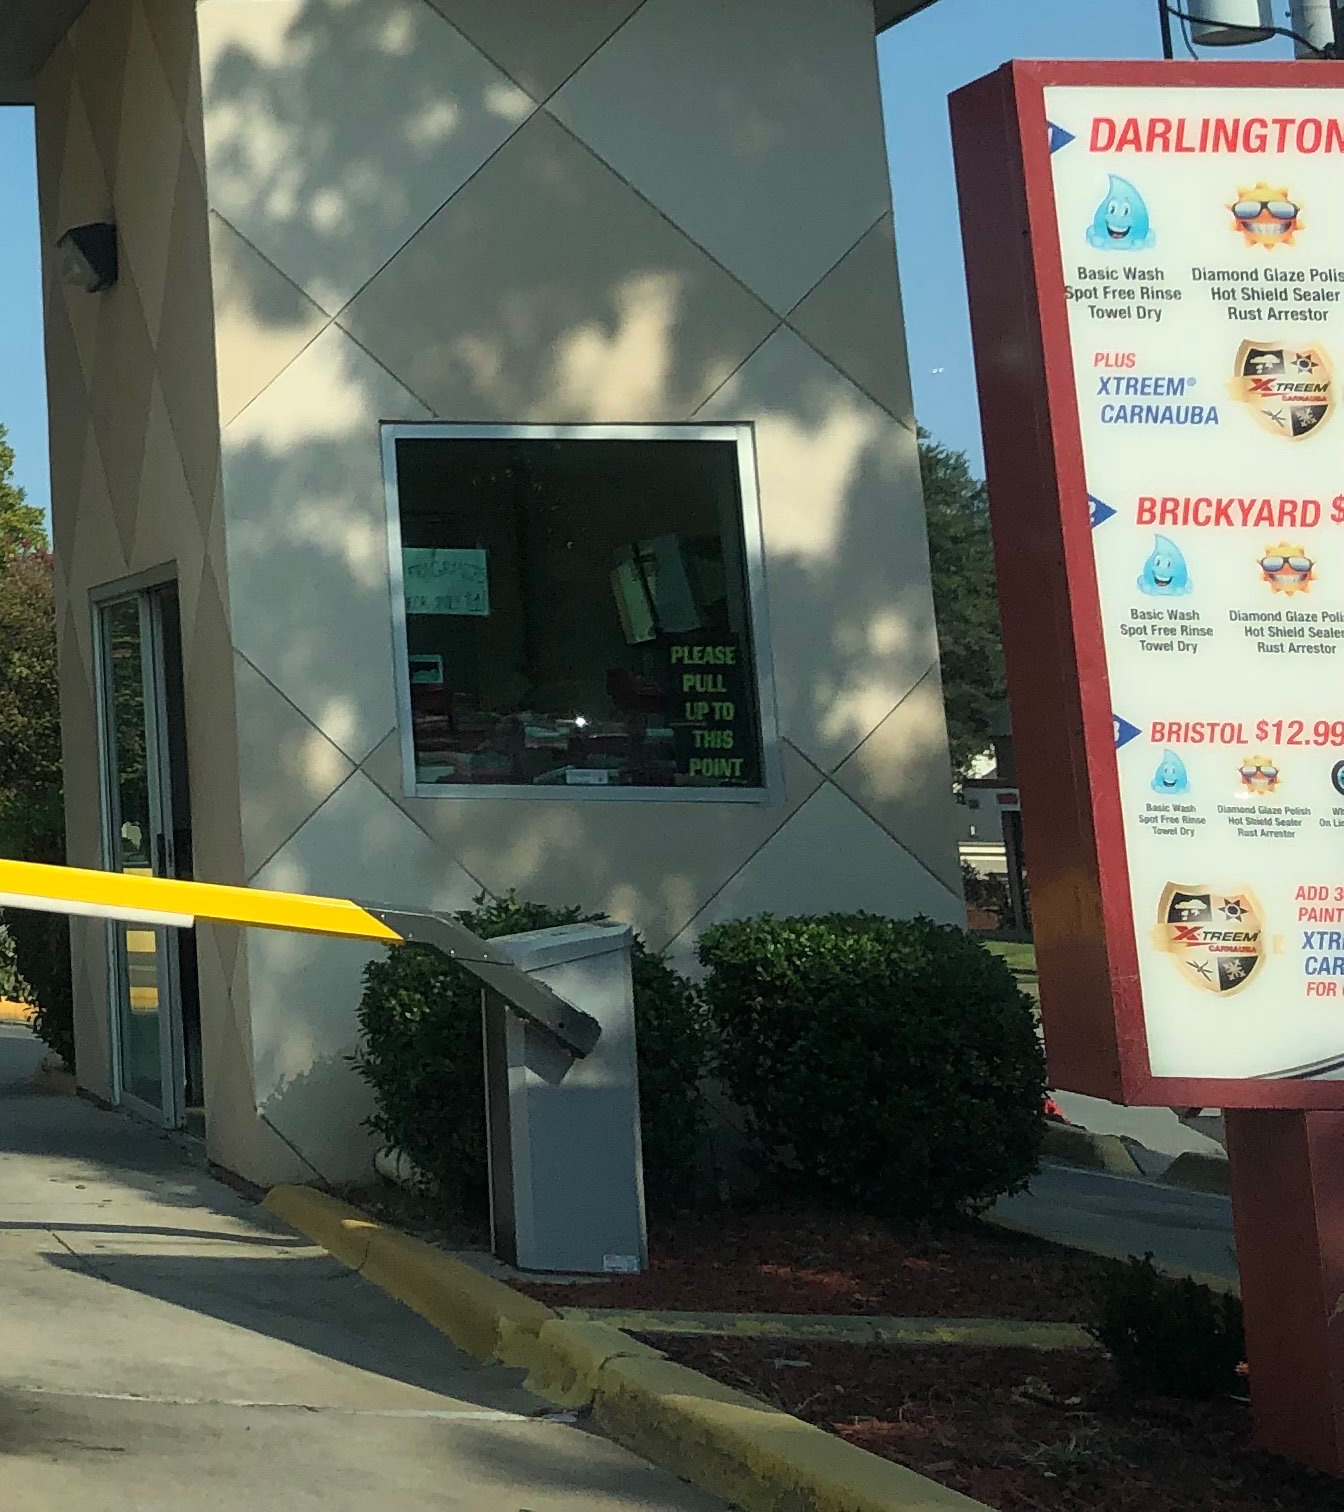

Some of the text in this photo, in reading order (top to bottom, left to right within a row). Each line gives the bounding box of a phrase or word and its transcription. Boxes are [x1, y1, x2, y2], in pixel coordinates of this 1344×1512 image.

[1088, 116, 1344, 154] DARLINGTON
[1077, 266, 1165, 281] Basic Wash
[1191, 267, 1259, 283] Diamond
[1263, 267, 1305, 283] Glaze
[1065, 285, 1182, 303] Spot Free Rinse
[1211, 287, 1341, 302] Hot Shield Sealer
[1088, 304, 1162, 322] Towel Dry
[1227, 306, 1329, 321] Rust Arrestor
[1093, 352, 1137, 369] PLUS
[1100, 404, 1220, 425] CARNAUBA
[1135, 496, 1321, 527] BRICKYARD
[1130, 608, 1200, 621] Basic Wash
[1229, 609, 1282, 622] Diamond
[1285, 610, 1318, 623] Glaze
[1120, 623, 1214, 638] Spot Free Rinse
[1244, 625, 1265, 637] Hot
[1268, 626, 1305, 638] Shield
[670, 645, 737, 665] PLEASE
[1139, 640, 1198, 654] Towel Dry
[1257, 641, 1337, 654] Rust Arrestor
[682, 673, 728, 694] PULL
[685, 701, 735, 721] UP TO
[691, 729, 734, 750] THIS
[1150, 721, 1249, 745] BRISTOL
[688, 757, 744, 778] POINT
[1294, 885, 1329, 901] ADD
[1301, 930, 1344, 950] XTR
[1306, 981, 1338, 997] FOR
